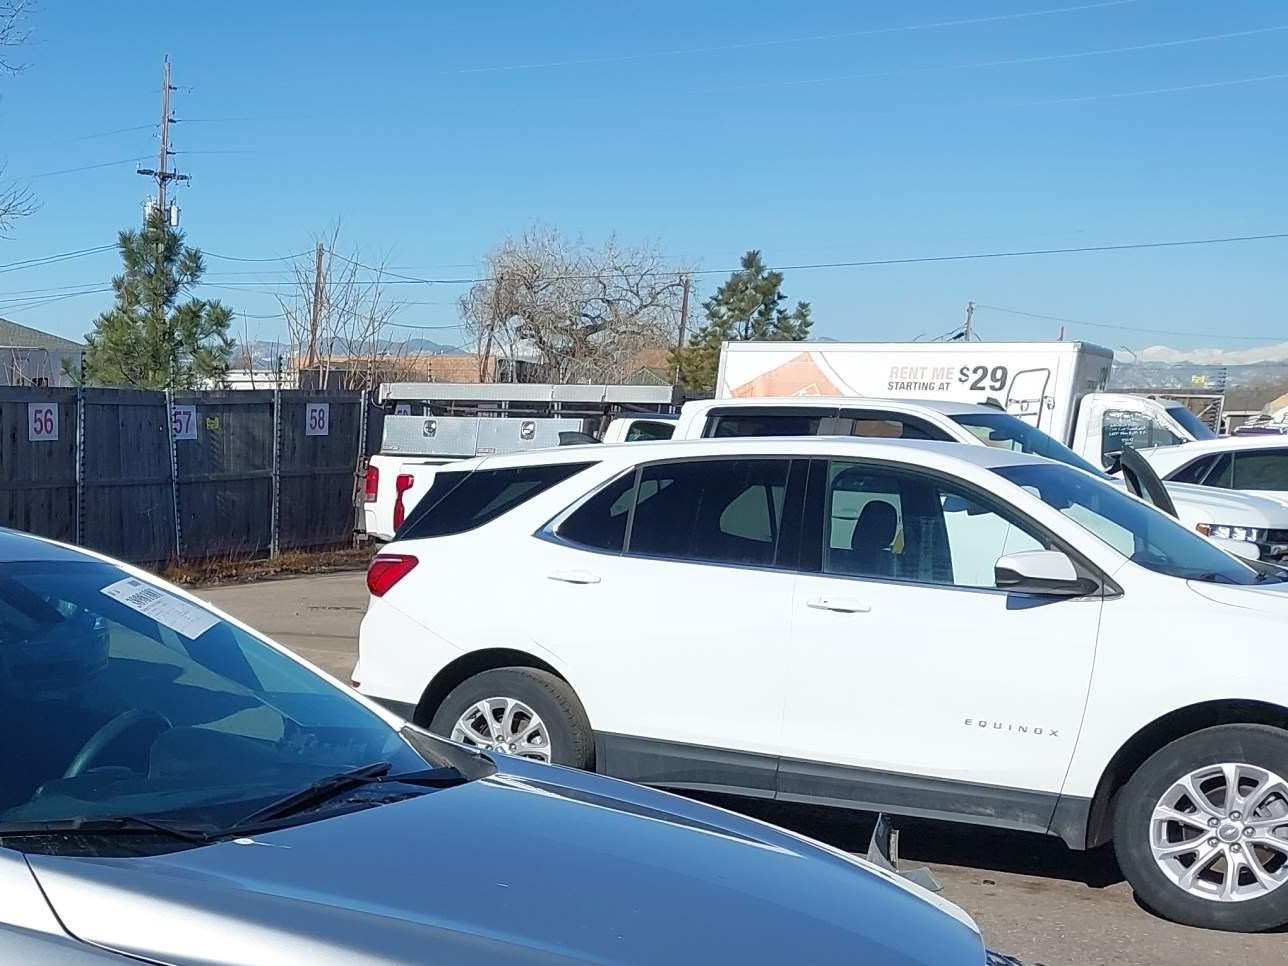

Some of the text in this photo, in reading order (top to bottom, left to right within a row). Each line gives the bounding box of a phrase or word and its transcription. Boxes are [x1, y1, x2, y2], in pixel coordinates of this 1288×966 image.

[887, 381, 951, 391] STARTING AT
[889, 365, 1008, 391] RENT ME $29
[33, 408, 54, 435] 56
[174, 410, 192, 434] 57
[310, 408, 325, 430] 58
[963, 718, 1060, 737] EQUINOX
